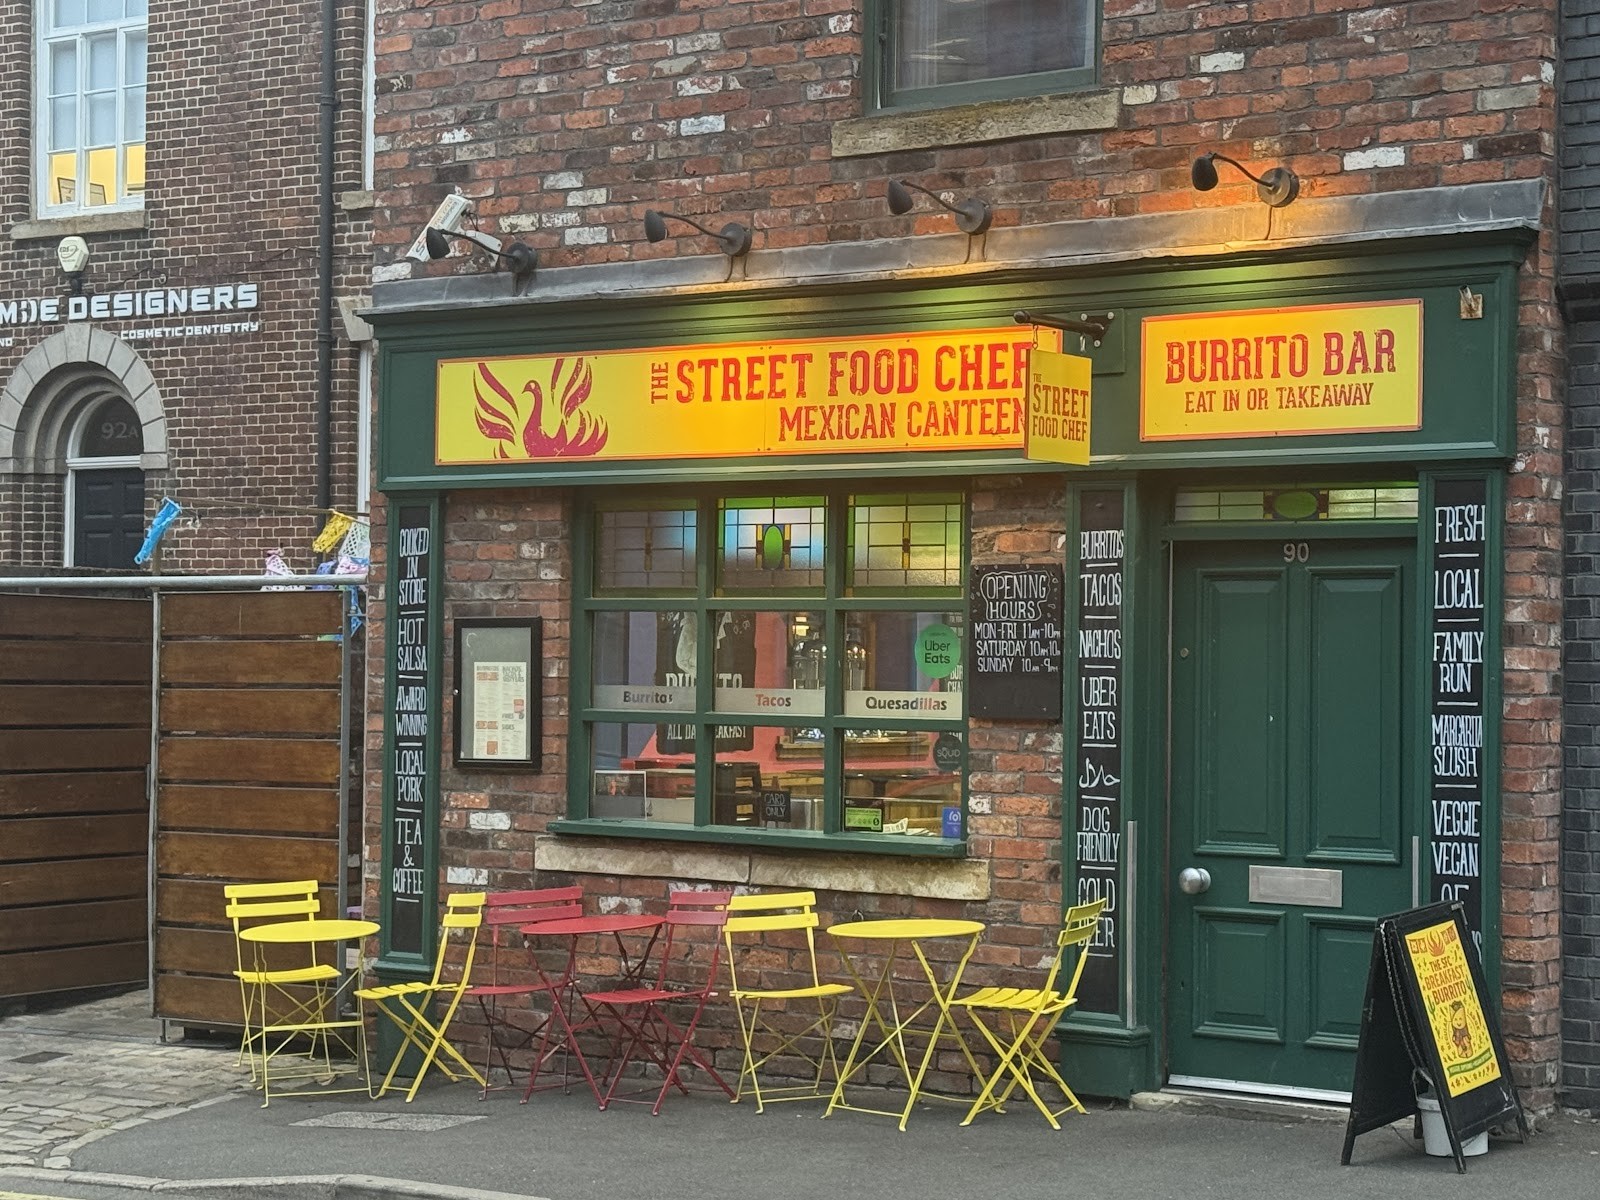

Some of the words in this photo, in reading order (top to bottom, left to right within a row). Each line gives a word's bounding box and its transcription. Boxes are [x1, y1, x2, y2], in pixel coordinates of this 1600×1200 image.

[69, 284, 258, 320] DESIGNERS
[121, 327, 183, 340] COSMETIC
[184, 321, 259, 337] DENTISTRY
[1165, 333, 1308, 384] BURRITO
[1322, 328, 1396, 376] BAR
[651, 362, 669, 404] THE
[676, 352, 813, 404] STREET
[828, 348, 919, 397] FOOD
[935, 342, 1032, 392] CHEF
[1033, 383, 1089, 419] STREET
[1184, 390, 1216, 413] EAT
[1223, 388, 1240, 411] IN
[1246, 387, 1269, 410] OR
[1276, 382, 1374, 409] TAKEAWAY
[779, 402, 896, 442] MEXICAN
[1032, 415, 1058, 438] FOOD
[1062, 419, 1087, 442] CHEF
[1434, 504, 1486, 543] FRESH
[400, 527, 429, 557] COOKED
[1080, 530, 1123, 559] BURRITOS
[1283, 543, 1309, 563] 90
[406, 556, 418, 578] IN
[399, 577, 427, 605] STORE
[986, 574, 1047, 599] OPENING
[1081, 573, 1122, 606] TACOS
[1434, 568, 1484, 609] LOCAL
[989, 601, 1035, 619] HOURS
[398, 618, 424, 645] HOT
[1079, 629, 1121, 659] NACHOS
[397, 646, 427, 671] SALSA
[924, 640, 951, 652] Uber
[924, 652, 951, 664] Eats
[976, 640, 1027, 657] SATURDAY
[1433, 631, 1484, 663] FAMILY
[977, 657, 1014, 673] SUNDAY
[1439, 663, 1473, 693] RUN
[395, 686, 427, 711] AWARD
[755, 693, 792, 707] Tacos
[865, 696, 948, 711] Quesadillas
[1082, 676, 1117, 707] UBER
[395, 713, 428, 737] WINNING
[1083, 711, 1116, 740] EATS
[395, 750, 426, 775] LOCAL
[1434, 746, 1478, 777] SLUSH
[397, 776, 423, 802] PORK
[395, 818, 422, 845] TEA
[1083, 806, 1110, 833] DOG
[1432, 800, 1481, 837] VEGGIE
[403, 845, 414, 867] &
[1077, 832, 1120, 862] FRIENDLY
[1431, 841, 1479, 877] VEGAN
[393, 868, 424, 894] COFFEE
[1425, 964, 1465, 990] BREAKFAST
[1428, 959, 1442, 973] THE
[1432, 981, 1467, 1006] BURRITO
